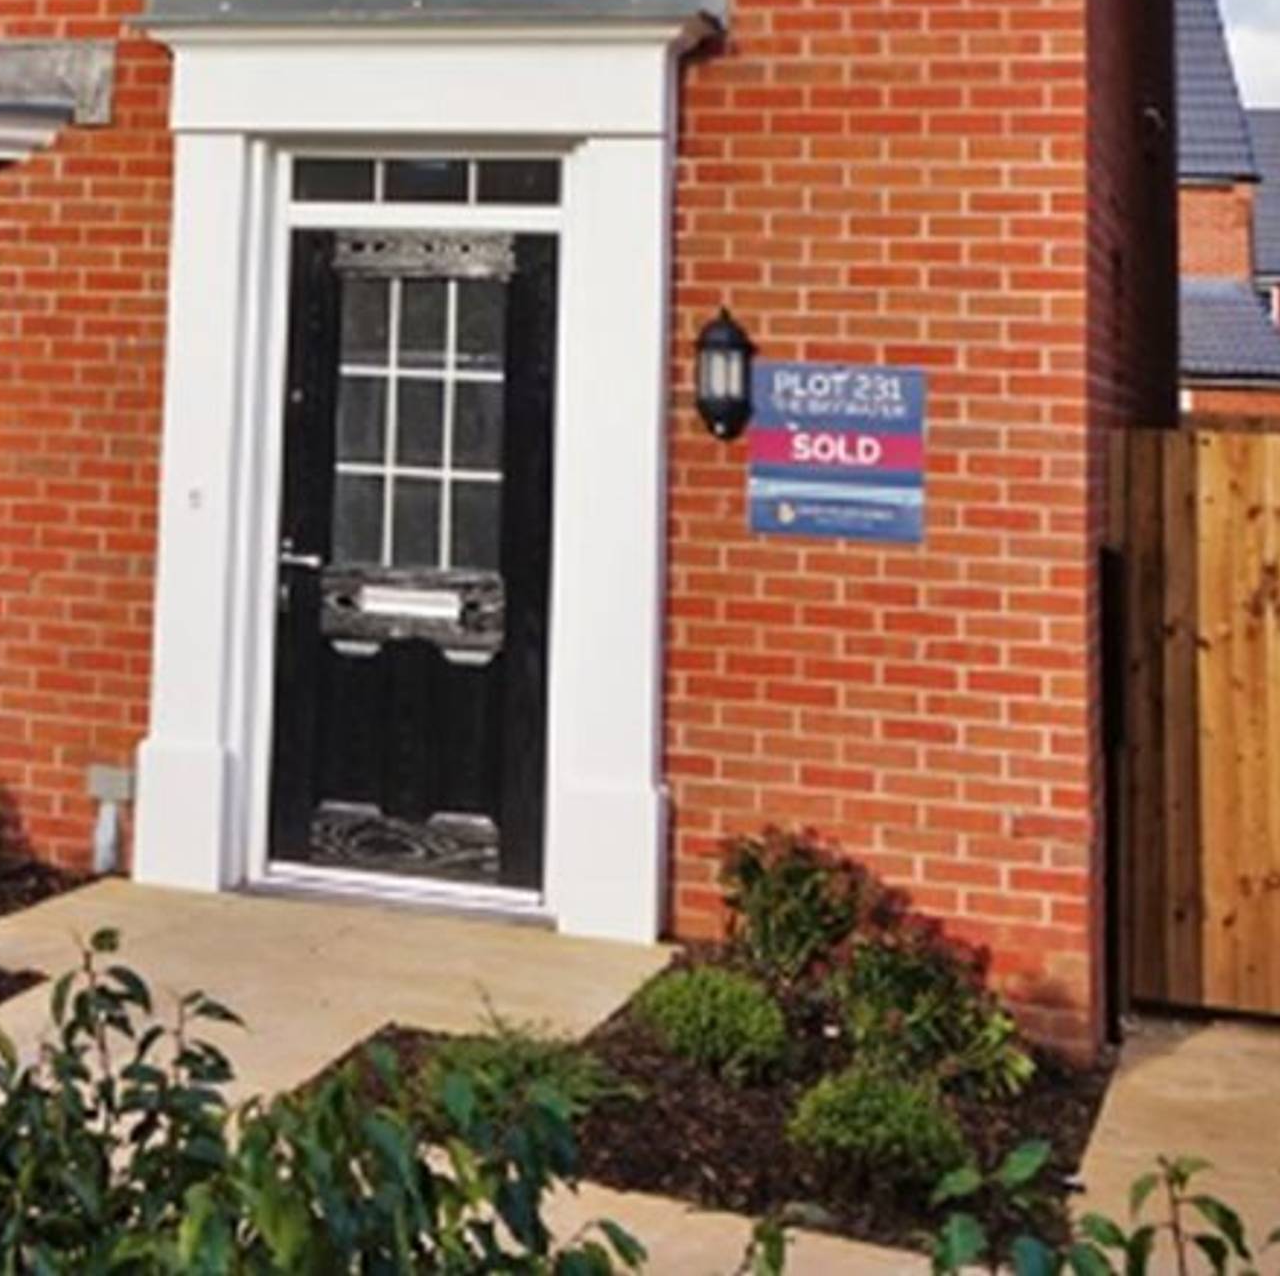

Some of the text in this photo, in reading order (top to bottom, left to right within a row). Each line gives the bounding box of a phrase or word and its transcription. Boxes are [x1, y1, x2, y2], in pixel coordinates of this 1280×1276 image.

[773, 370, 901, 401] PLOT 231
[791, 433, 882, 465] SOLD
